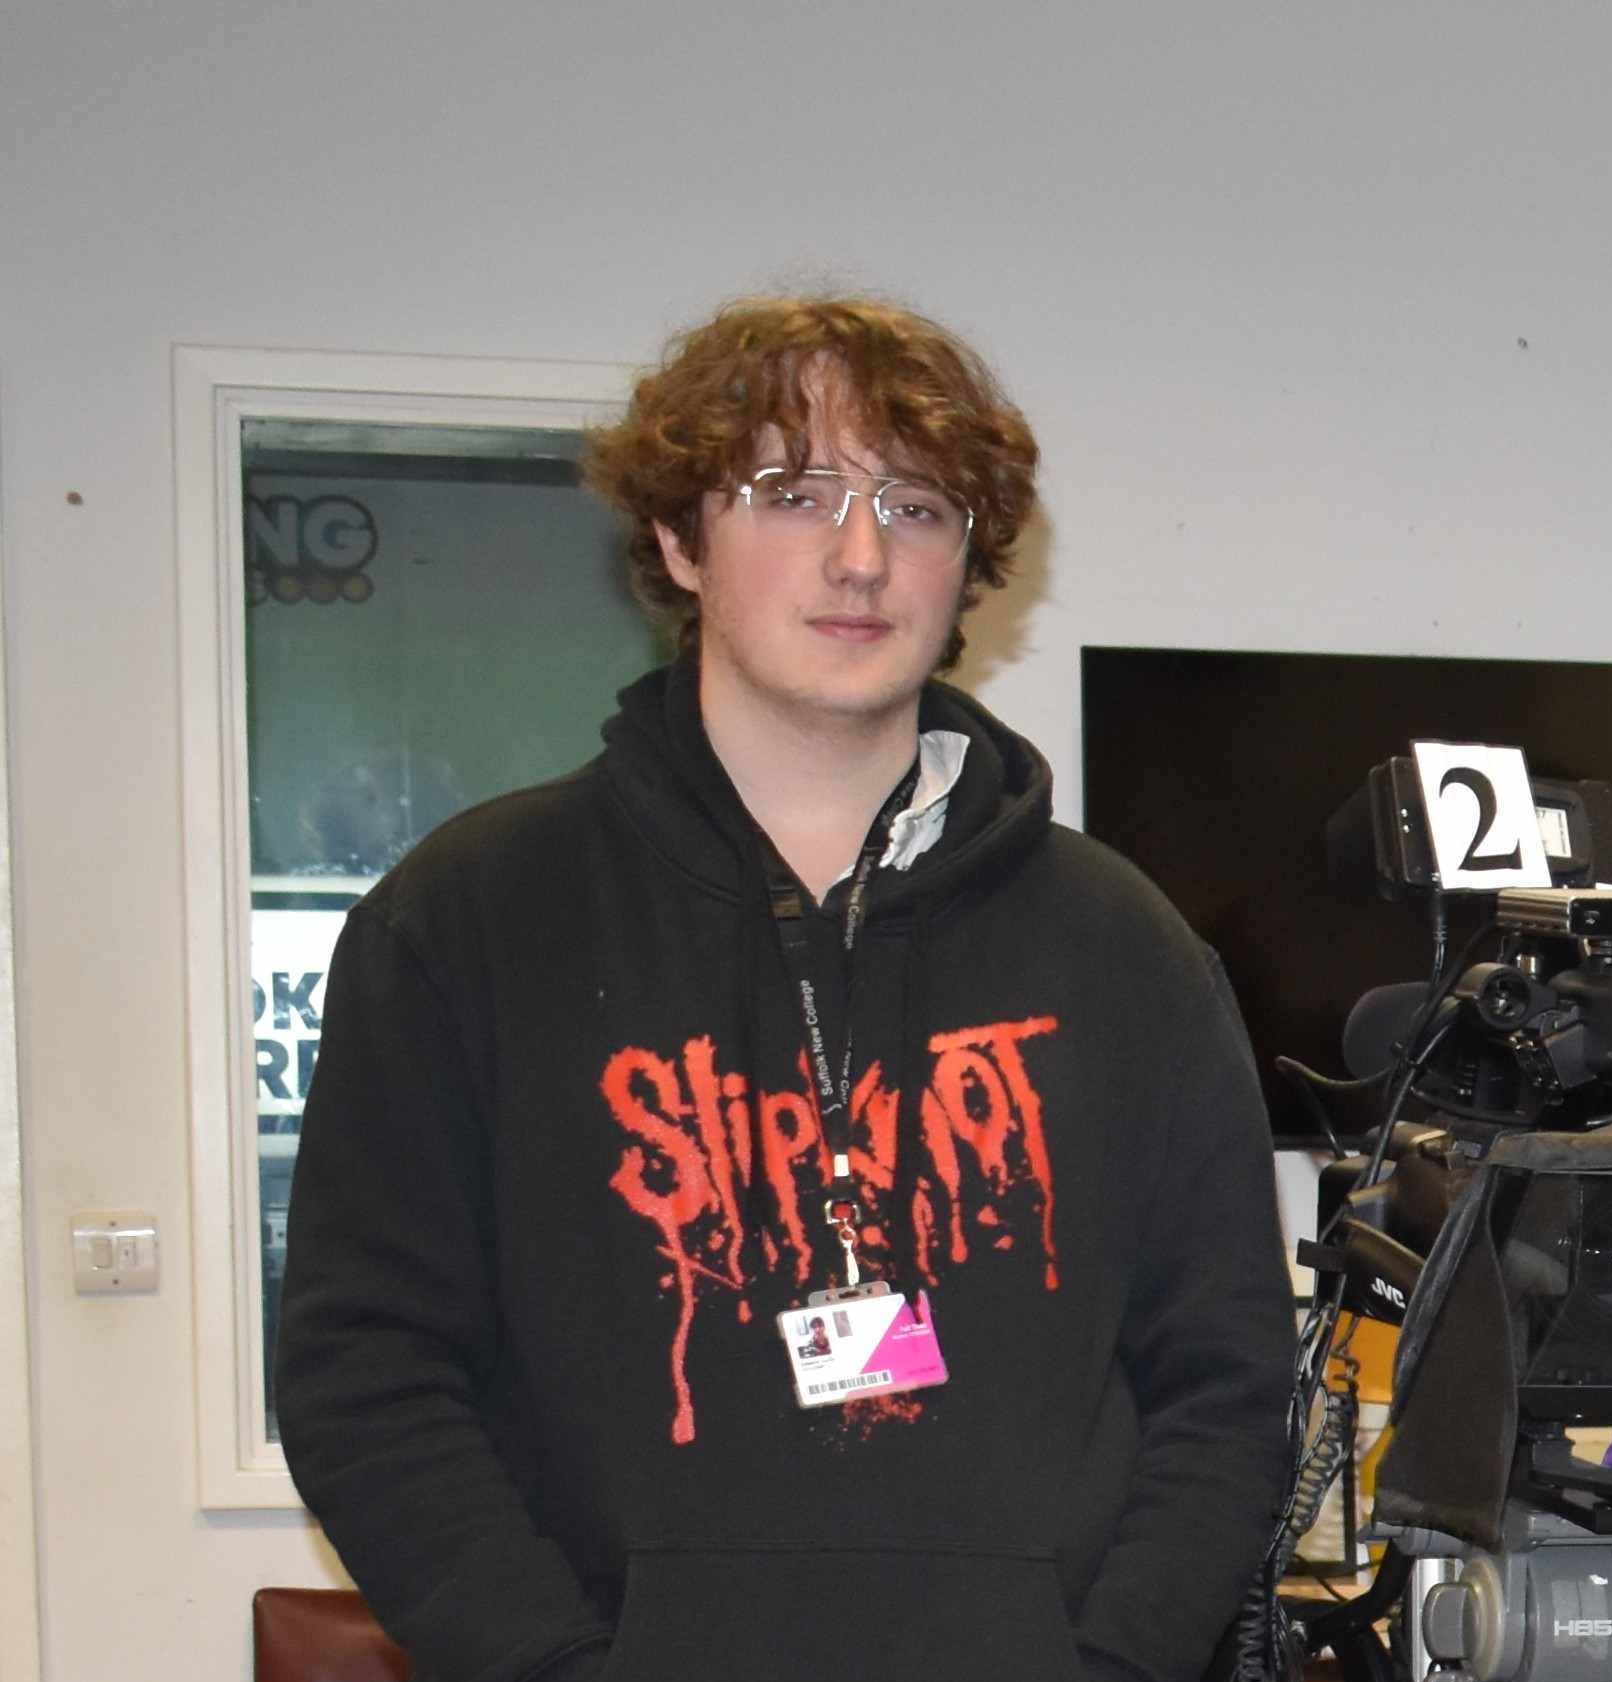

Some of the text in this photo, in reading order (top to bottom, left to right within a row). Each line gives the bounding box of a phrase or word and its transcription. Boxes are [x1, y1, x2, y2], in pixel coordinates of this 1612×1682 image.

[1438, 766, 1524, 871] 2
[800, 979, 834, 1097] Suffolk New College
[1371, 1276, 1407, 1310] JVC
